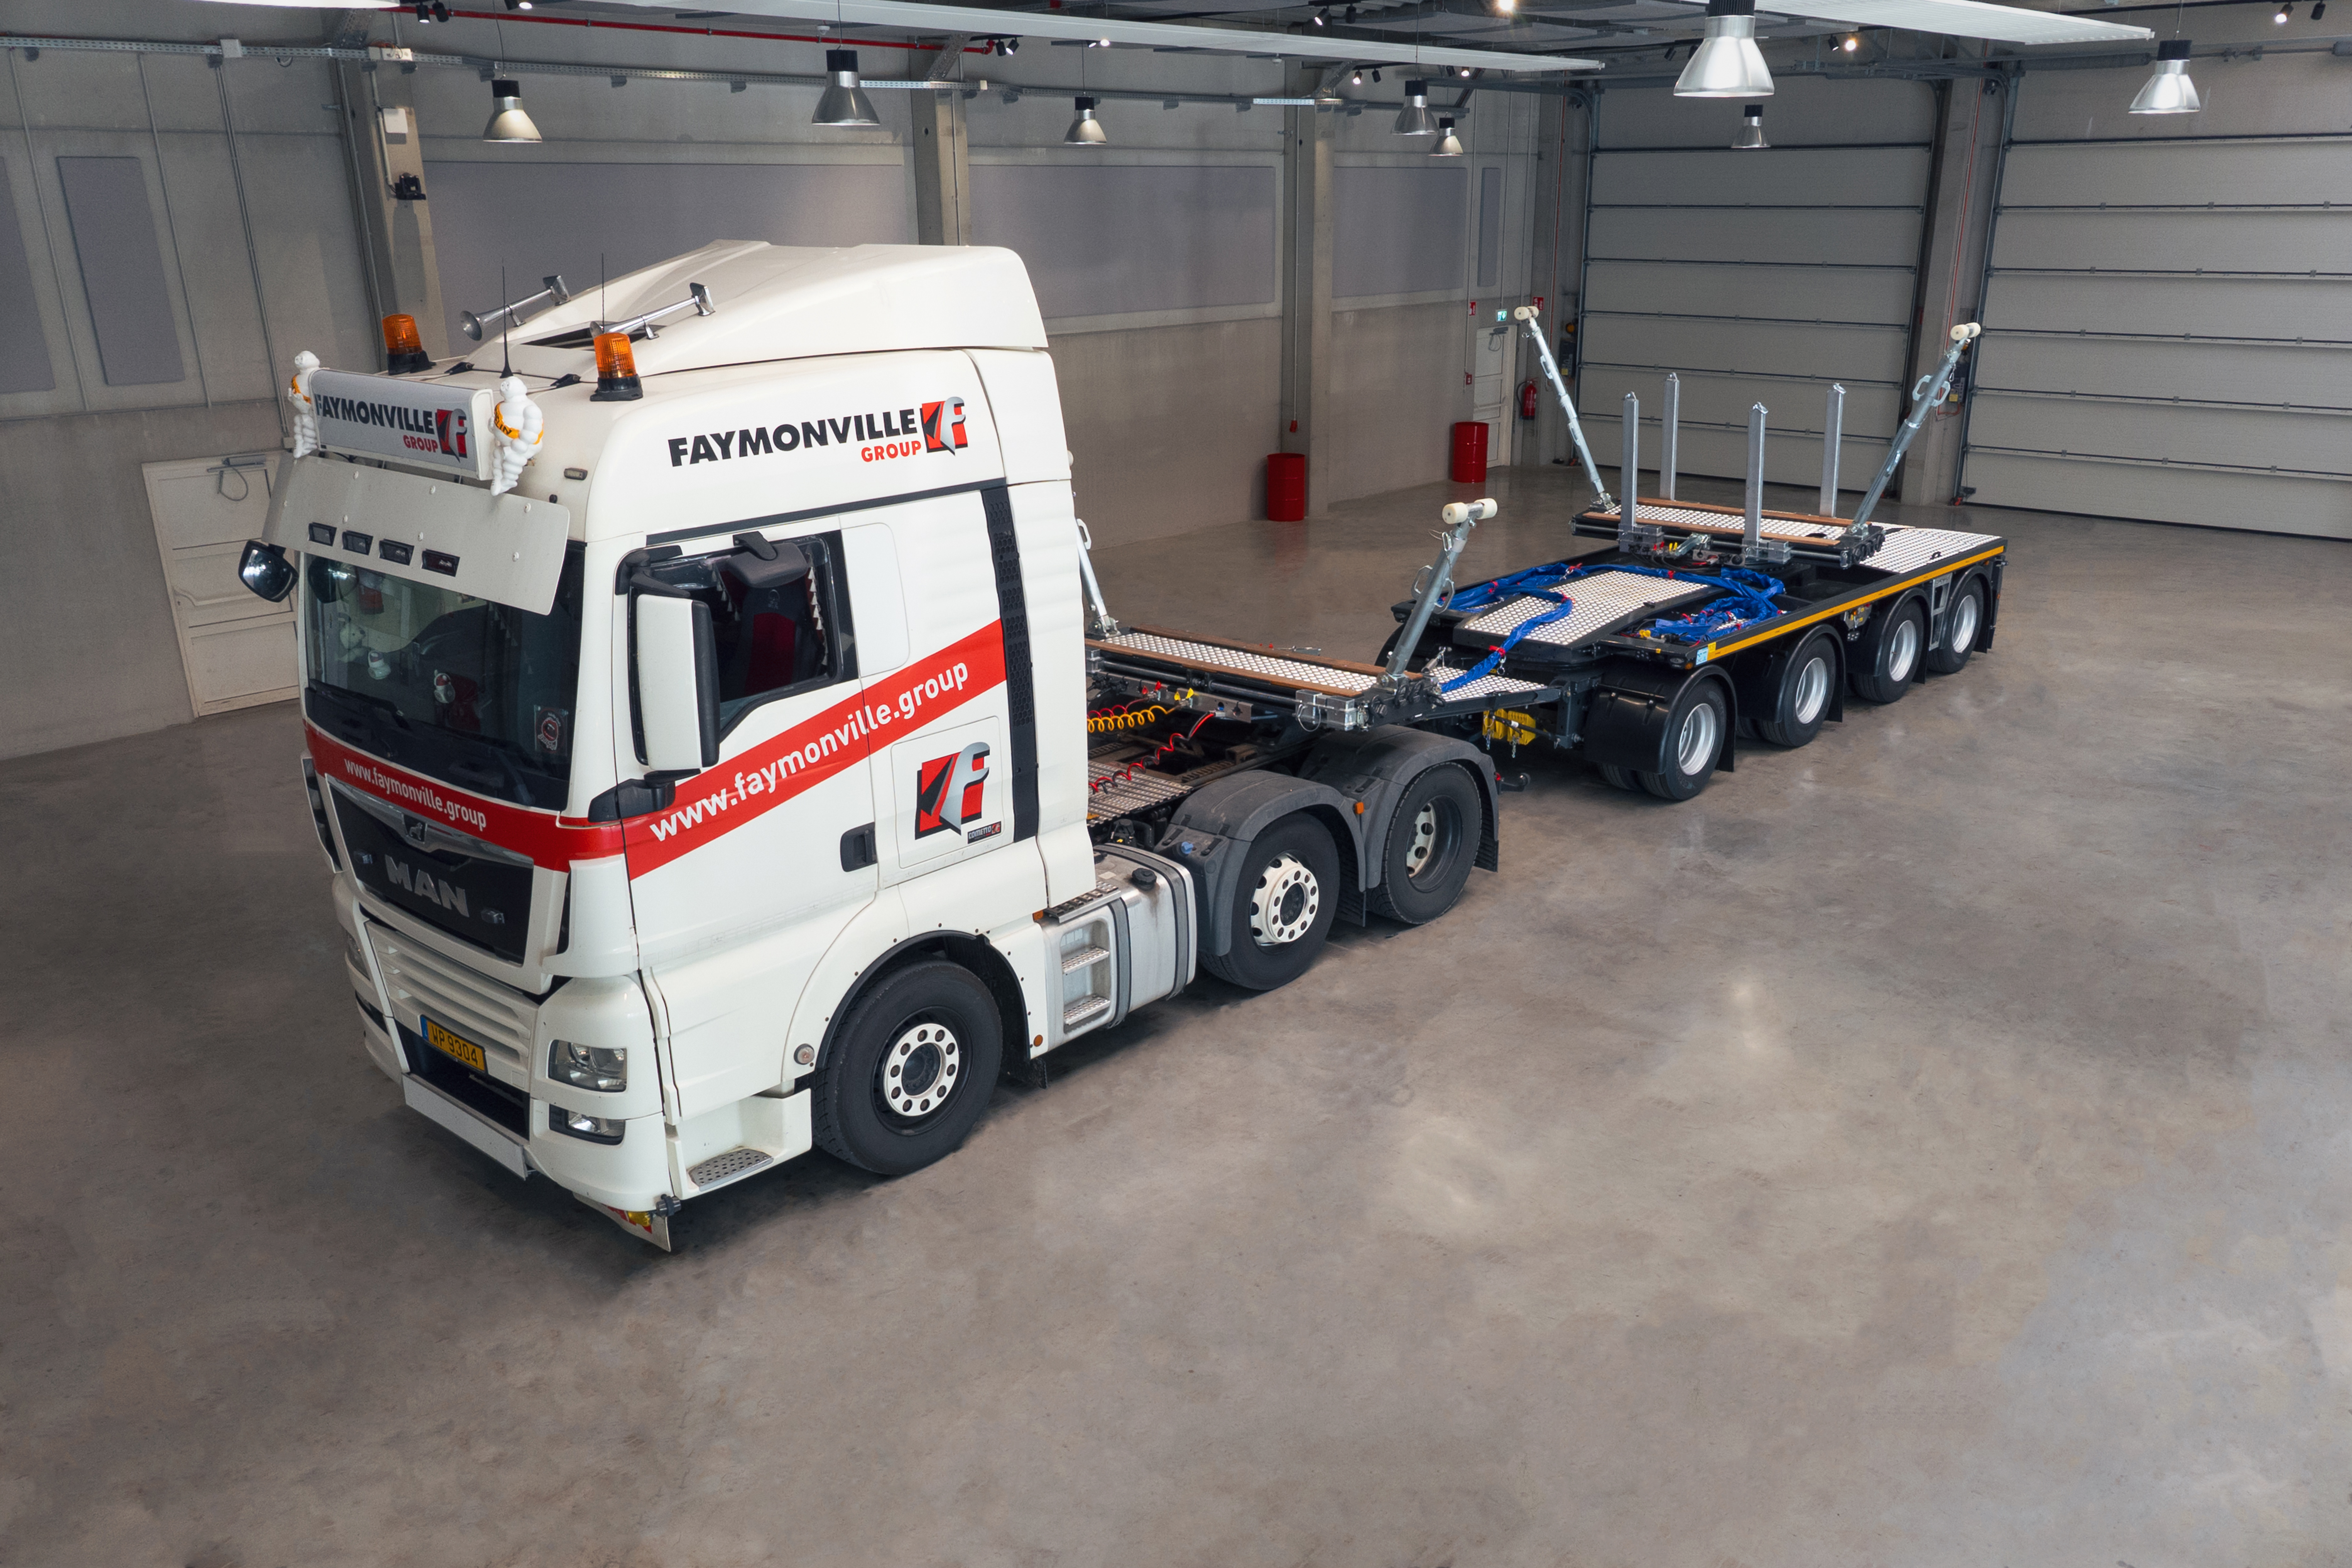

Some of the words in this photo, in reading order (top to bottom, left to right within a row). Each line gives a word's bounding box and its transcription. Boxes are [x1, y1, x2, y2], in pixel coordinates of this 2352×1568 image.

[314, 394, 435, 434] FAYMONVILLE
[668, 408, 917, 467] FAYMONVILLE
[403, 435, 438, 453] GROUP
[861, 440, 922, 463] GROUP
[649, 662, 968, 842] www.faymonville.group
[343, 758, 487, 832] www.faymonville.group
[384, 853, 470, 918] MAN
[448, 1035, 478, 1066] 9304
